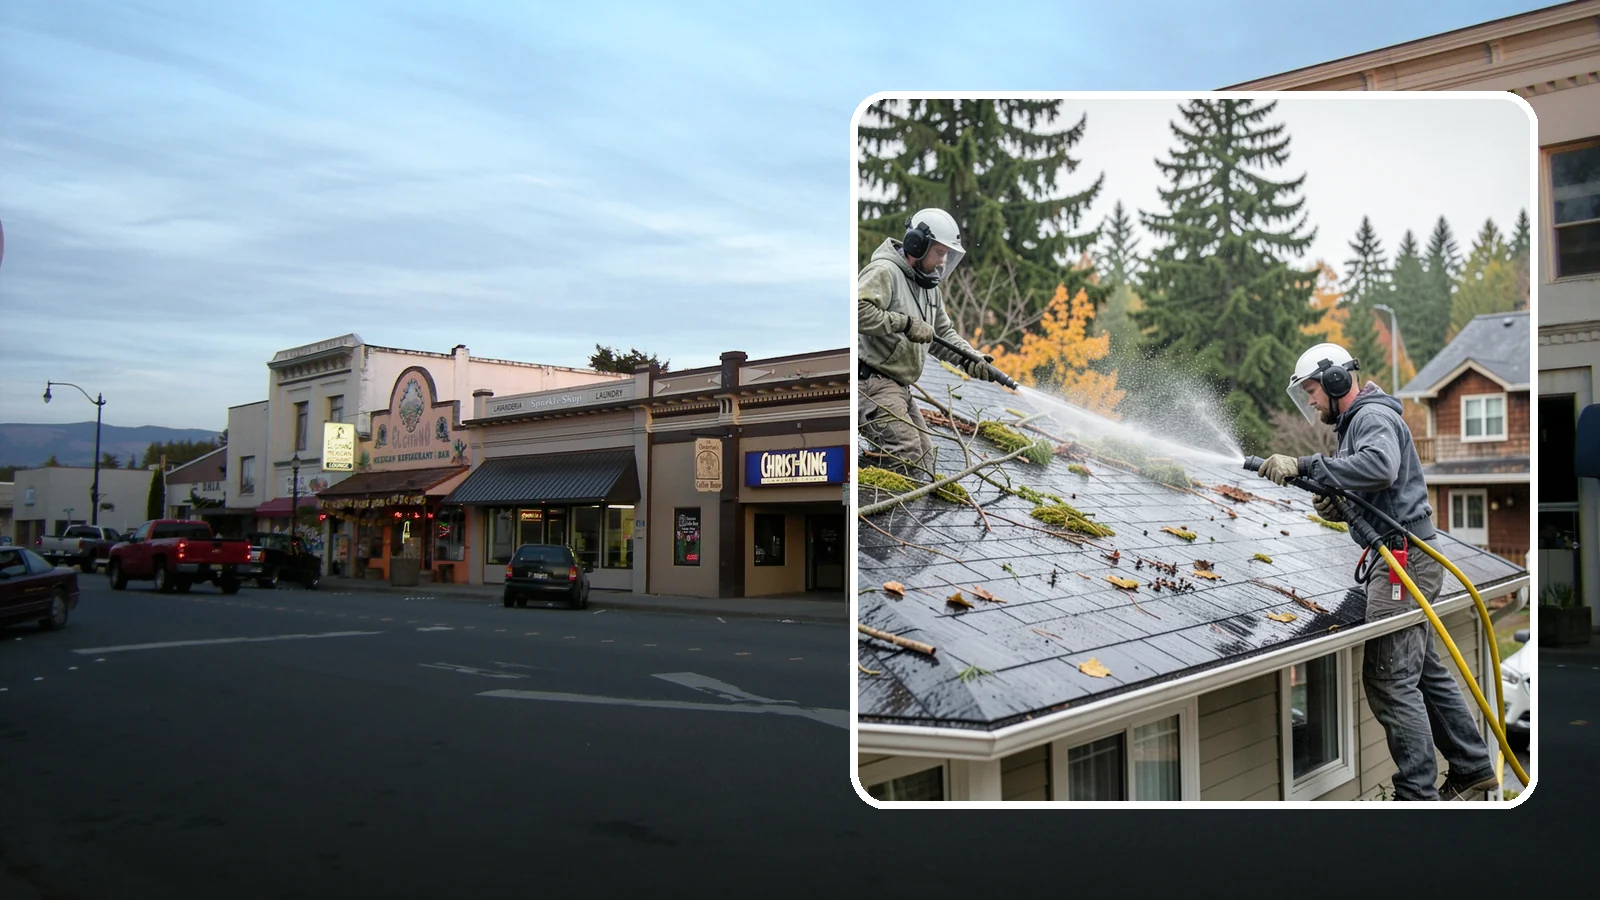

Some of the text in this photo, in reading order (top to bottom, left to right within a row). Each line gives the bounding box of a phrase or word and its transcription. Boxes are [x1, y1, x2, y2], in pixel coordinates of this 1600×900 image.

[596, 389, 624, 400] LAUNDRY
[494, 402, 523, 412] LAVANDERIA
[530, 395, 582, 408] Sparkle Shop
[374, 450, 450, 464] MEXICAN RESTAURANT BAR
